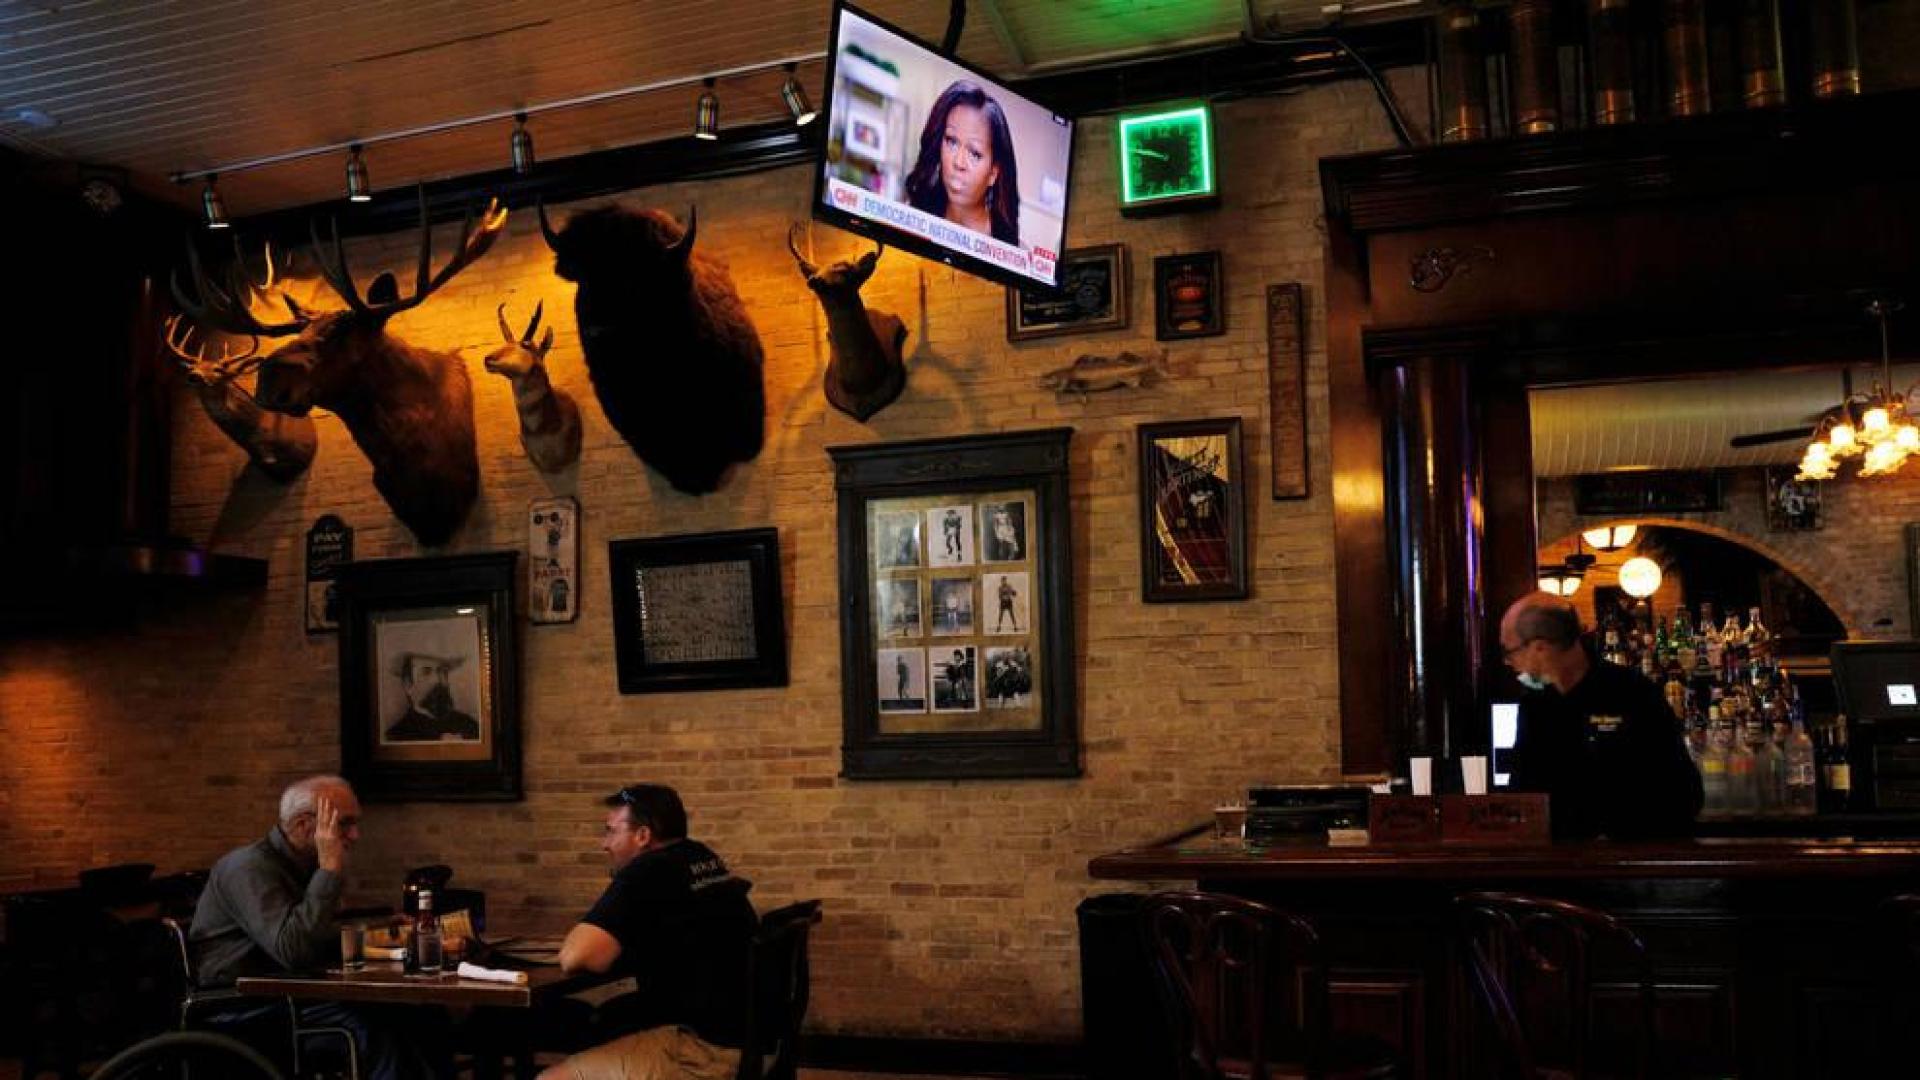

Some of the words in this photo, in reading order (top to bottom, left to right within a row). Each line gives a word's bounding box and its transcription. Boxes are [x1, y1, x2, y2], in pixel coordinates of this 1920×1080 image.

[835, 188, 858, 208] CNN
[864, 197, 927, 234] DEMOCRATIC
[929, 222, 970, 249] NATIONAL
[974, 236, 1027, 271] CONVENTION
